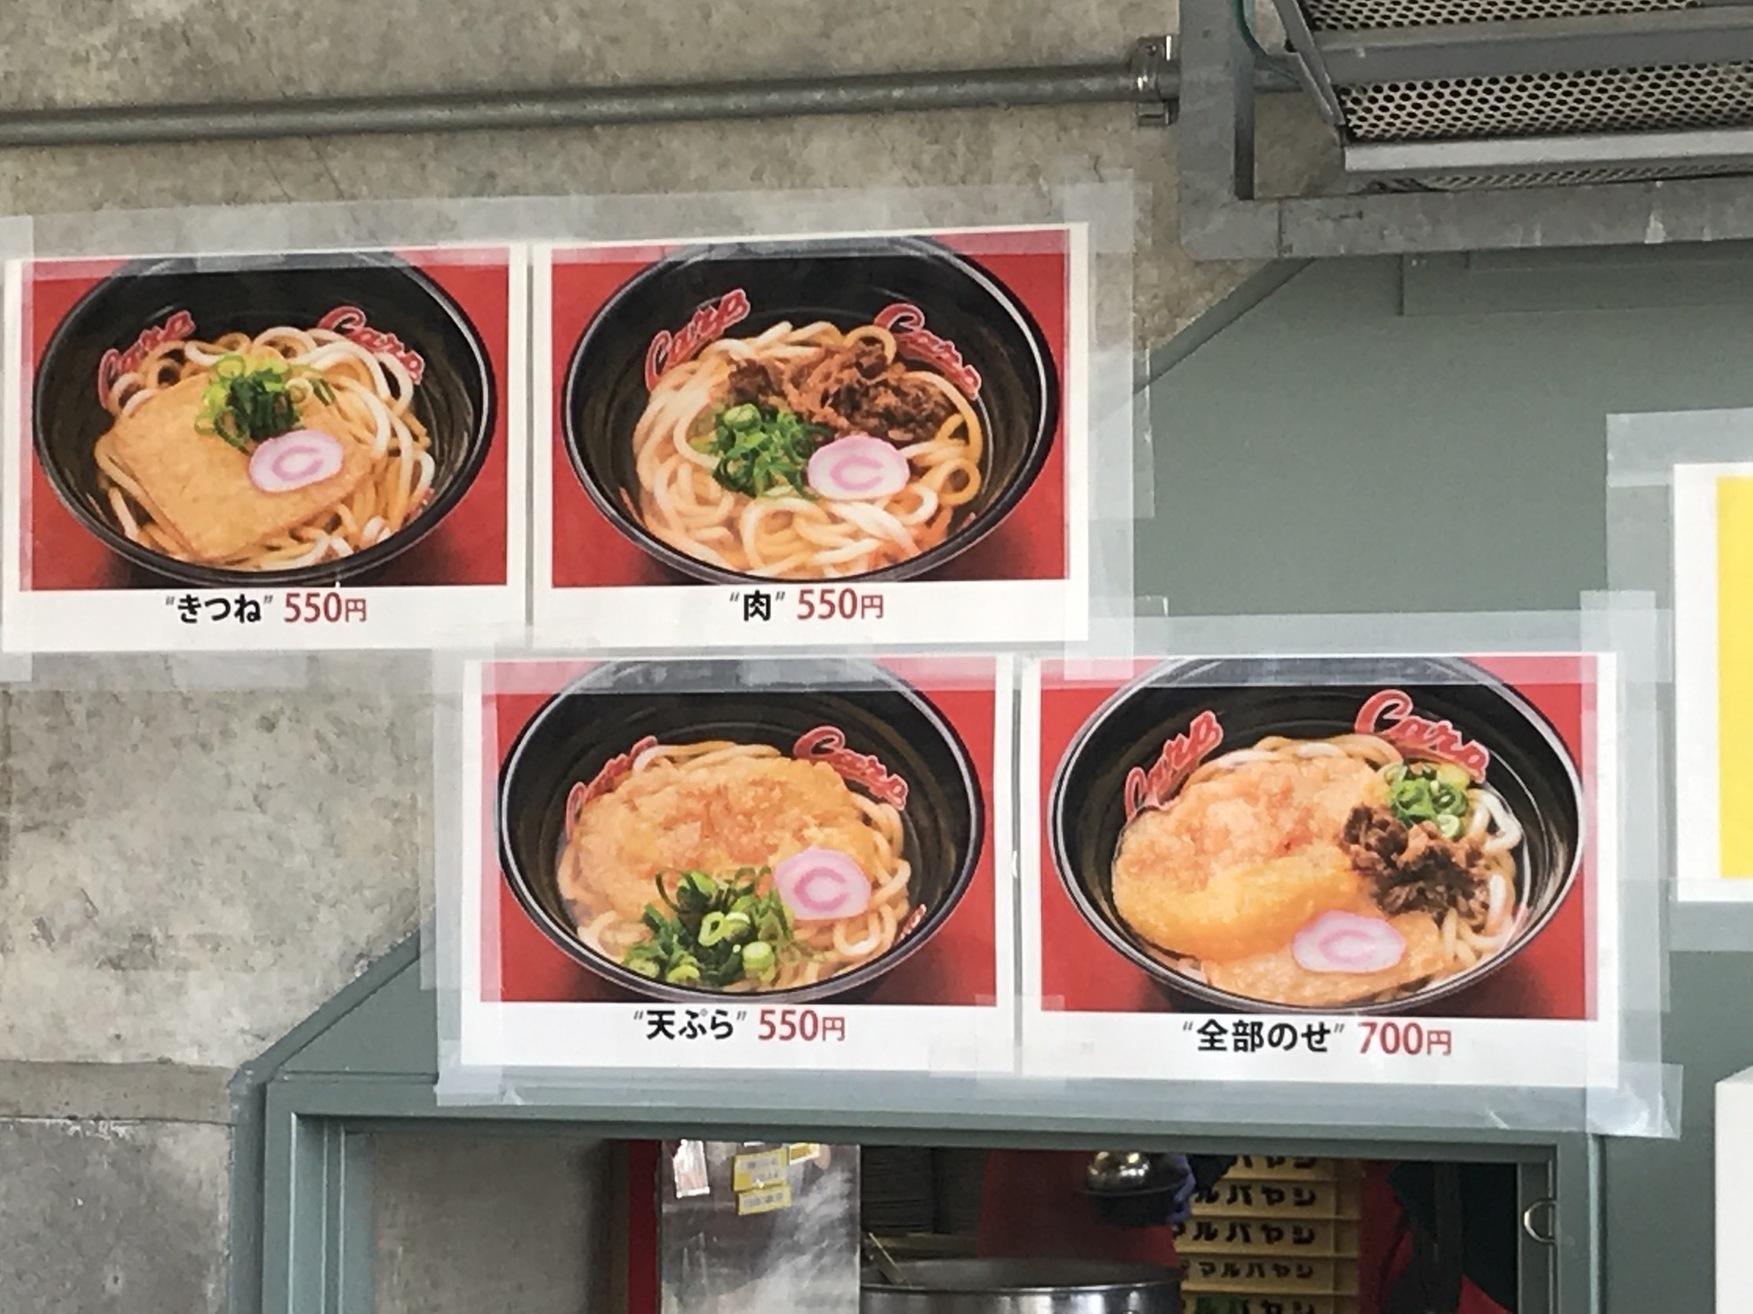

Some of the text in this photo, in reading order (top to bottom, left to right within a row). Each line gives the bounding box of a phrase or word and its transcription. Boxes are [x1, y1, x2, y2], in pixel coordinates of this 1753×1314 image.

[284, 591, 367, 623] 550円
[797, 587, 884, 620] 550円
[757, 1008, 846, 1042] 550円
[1357, 1021, 1452, 1056] 700円
